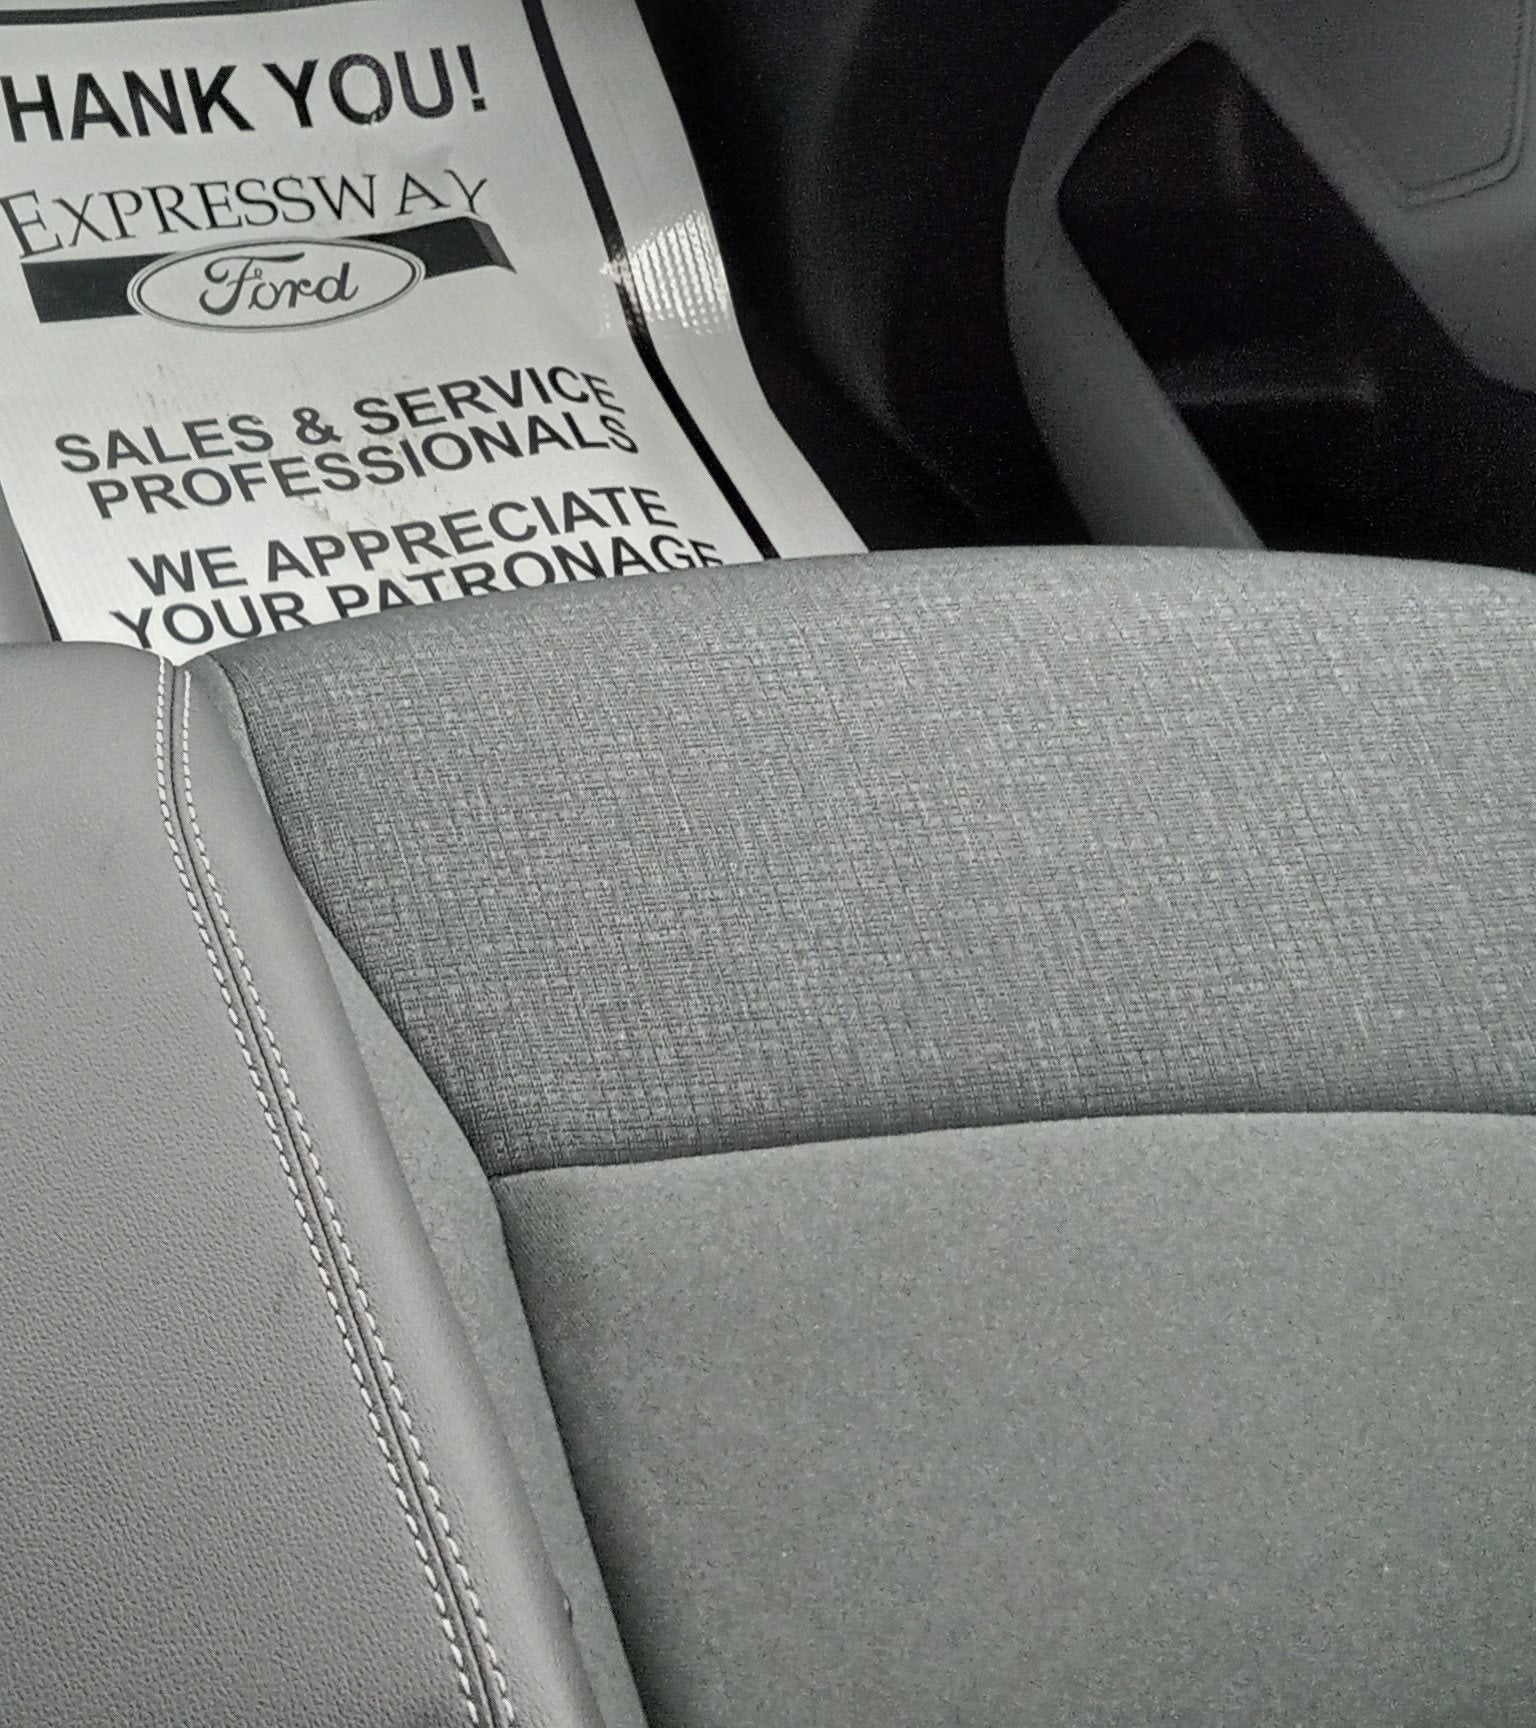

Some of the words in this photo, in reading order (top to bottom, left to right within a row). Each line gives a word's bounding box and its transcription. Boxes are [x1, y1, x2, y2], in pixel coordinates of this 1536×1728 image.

[262, 44, 487, 129] YOU!
[199, 252, 359, 317] Ford
[55, 413, 272, 473] SALES
[292, 406, 343, 446] &
[355, 366, 626, 436] SERVICE
[87, 411, 639, 520] PROFESSIONALS
[128, 544, 248, 597] WE
[265, 485, 678, 582] APPRECIATE
[108, 590, 312, 651] YOUR
